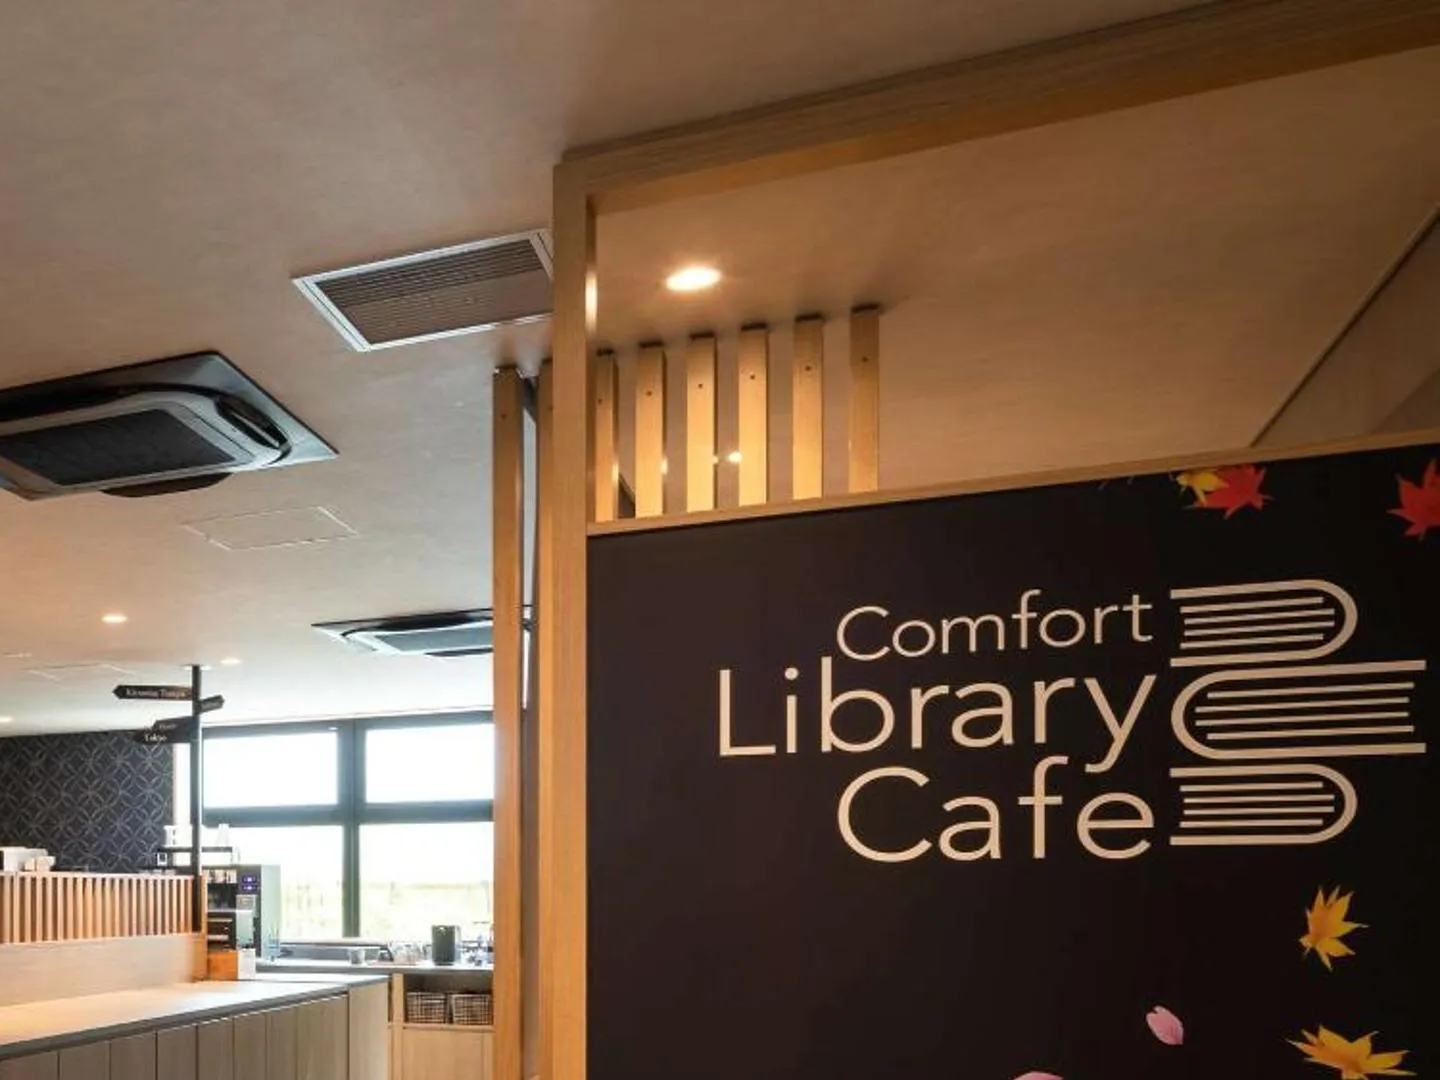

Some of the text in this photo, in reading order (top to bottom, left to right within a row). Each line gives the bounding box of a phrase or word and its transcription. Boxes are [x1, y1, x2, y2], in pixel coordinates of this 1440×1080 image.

[837, 590, 1153, 661] Comfort
[719, 657, 1157, 773] Library
[838, 756, 1154, 863] Cafe
